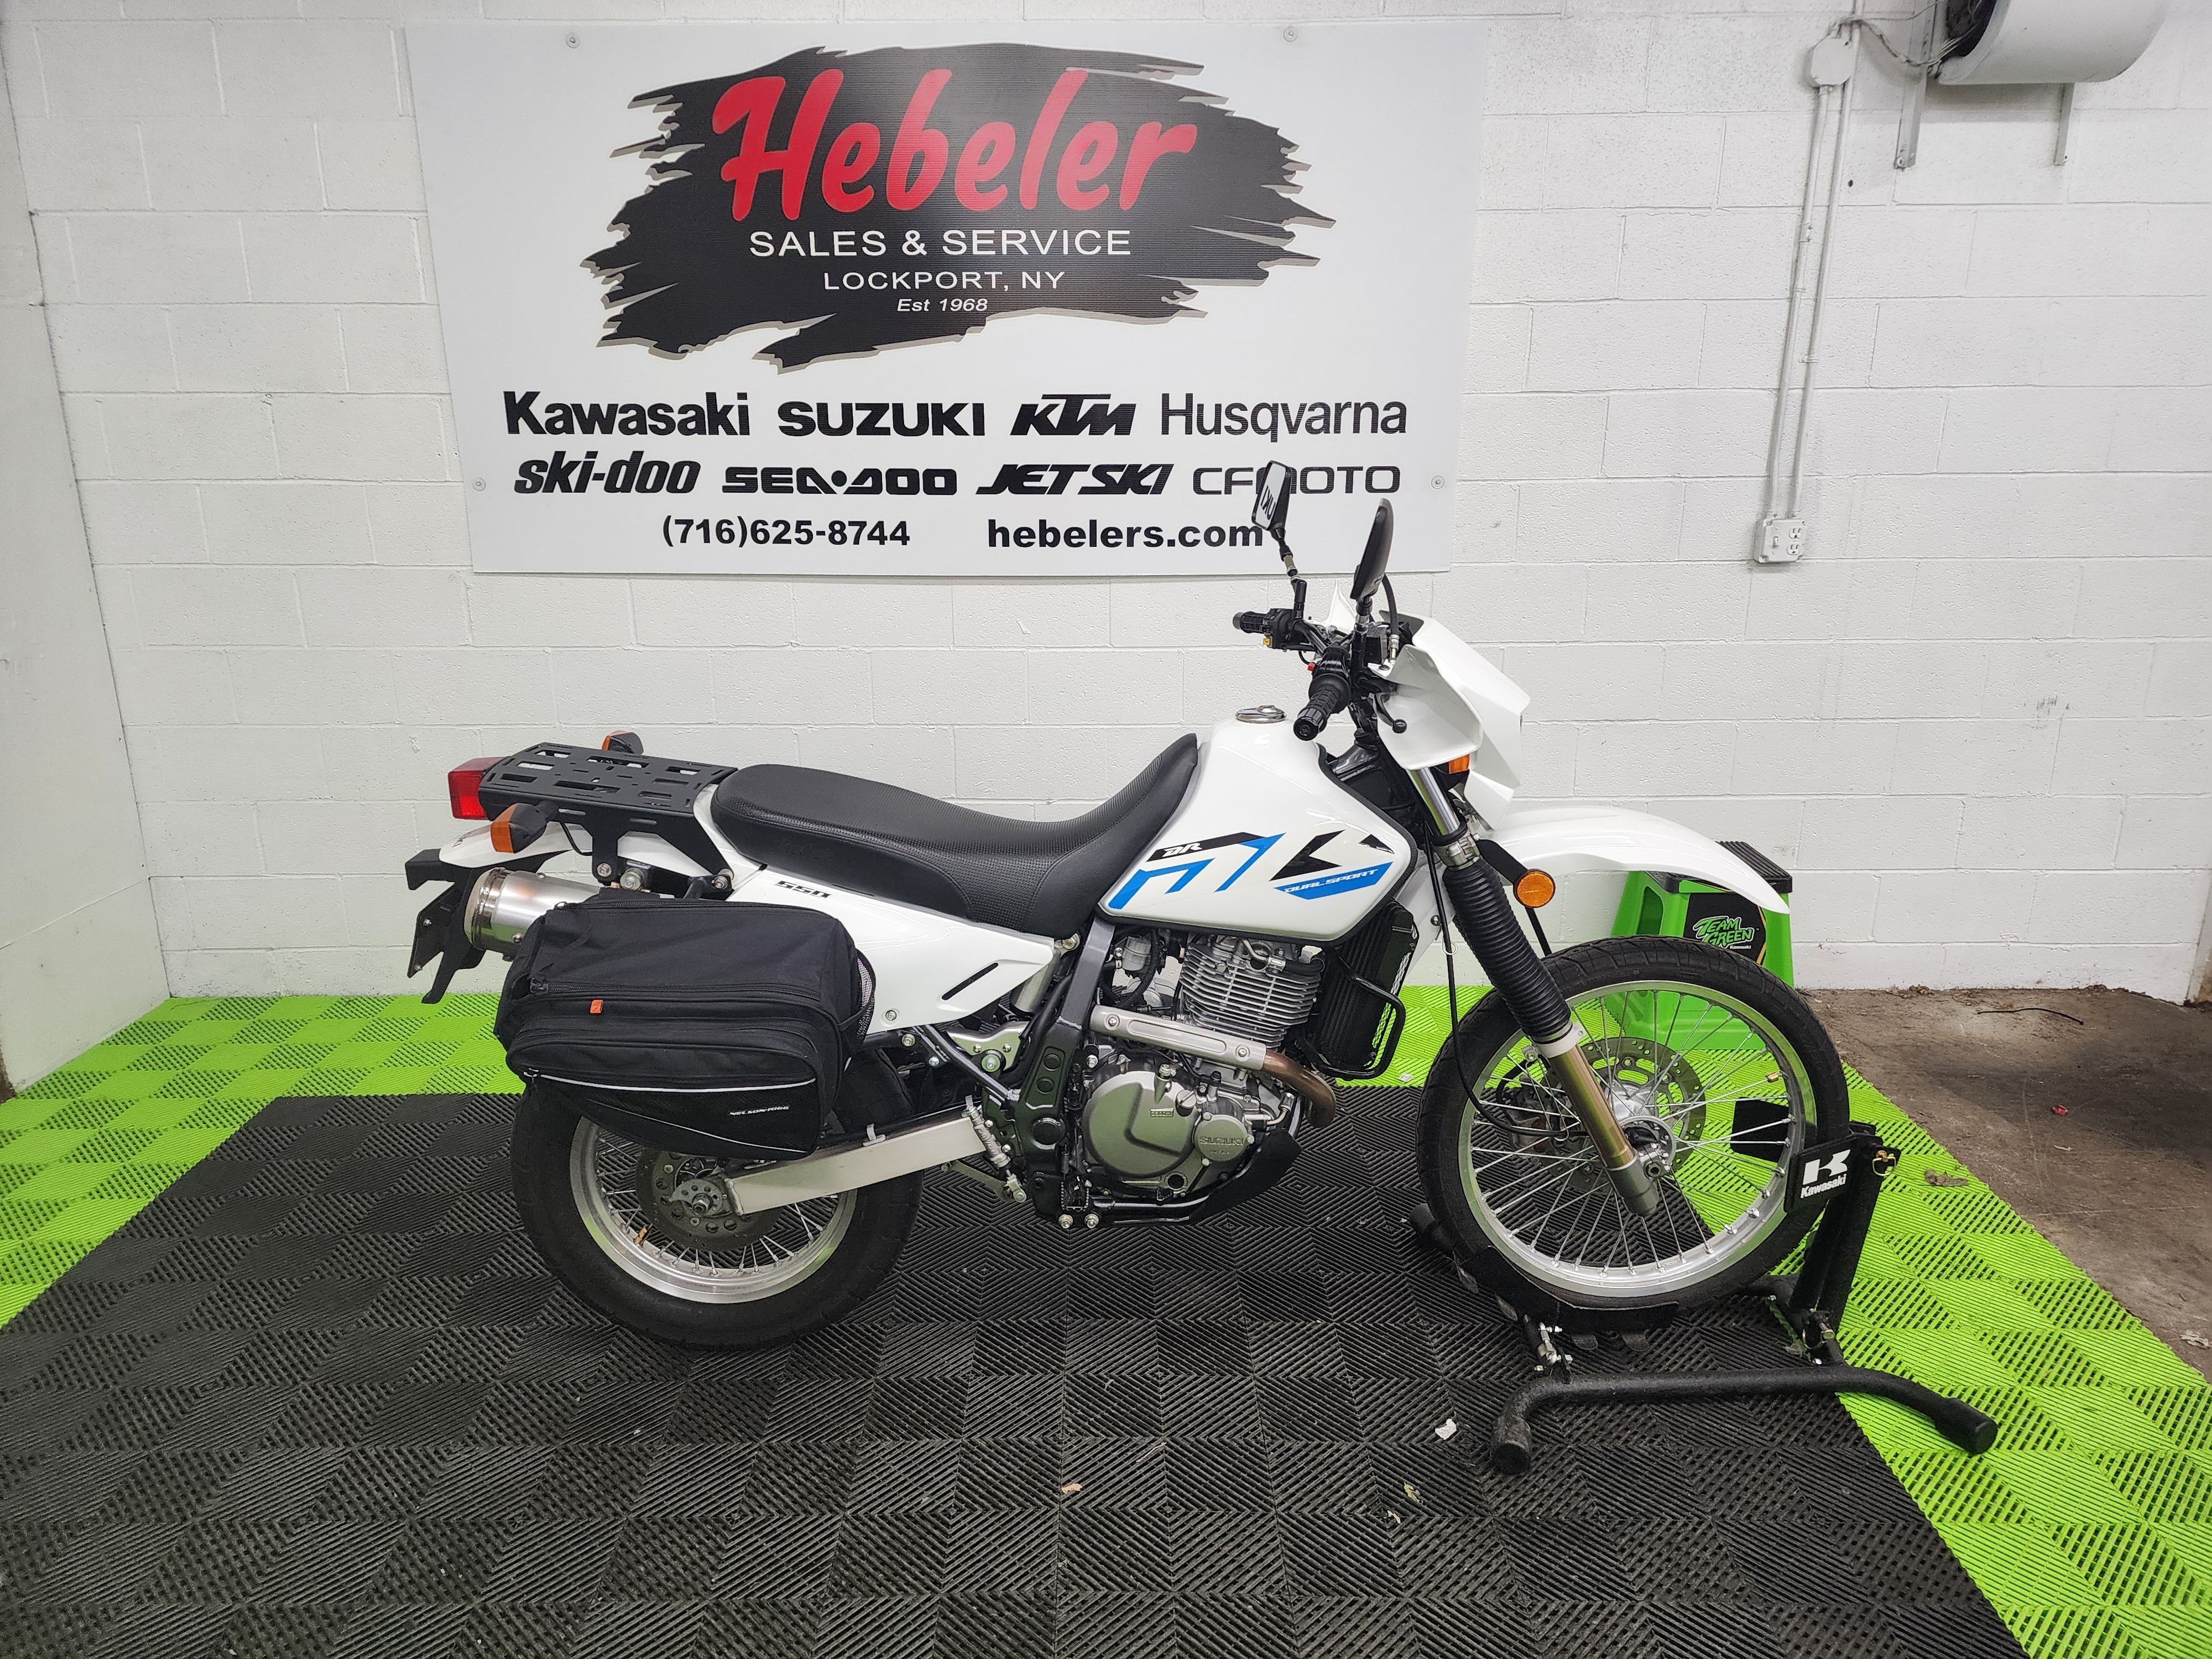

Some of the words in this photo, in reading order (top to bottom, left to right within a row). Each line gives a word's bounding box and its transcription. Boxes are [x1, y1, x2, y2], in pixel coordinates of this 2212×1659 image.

[712, 69, 1197, 221] Hebeler
[750, 230, 886, 257] SALES
[902, 229, 927, 256] &
[942, 229, 1131, 255] SERVICE
[824, 271, 1009, 291] LOCKPORT,
[1021, 271, 1065, 289] NY
[897, 299, 930, 312] Est
[939, 298, 988, 312] 1968
[503, 391, 750, 436] Kawasaki
[778, 401, 985, 437] SUZUKI
[1010, 394, 1136, 436] KTM
[1161, 393, 1407, 443] Husqvarna
[514, 450, 701, 494] ski-doo
[663, 515, 910, 548] (716)625-8744
[988, 519, 1263, 548] hebelers.com
[1284, 881, 1325, 893] DUAL
[1325, 869, 1379, 885] SPORT
[1694, 917, 1740, 937] TEAM
[1703, 929, 1752, 947] GREEN
[1800, 1173, 1847, 1198] Kawasaki
